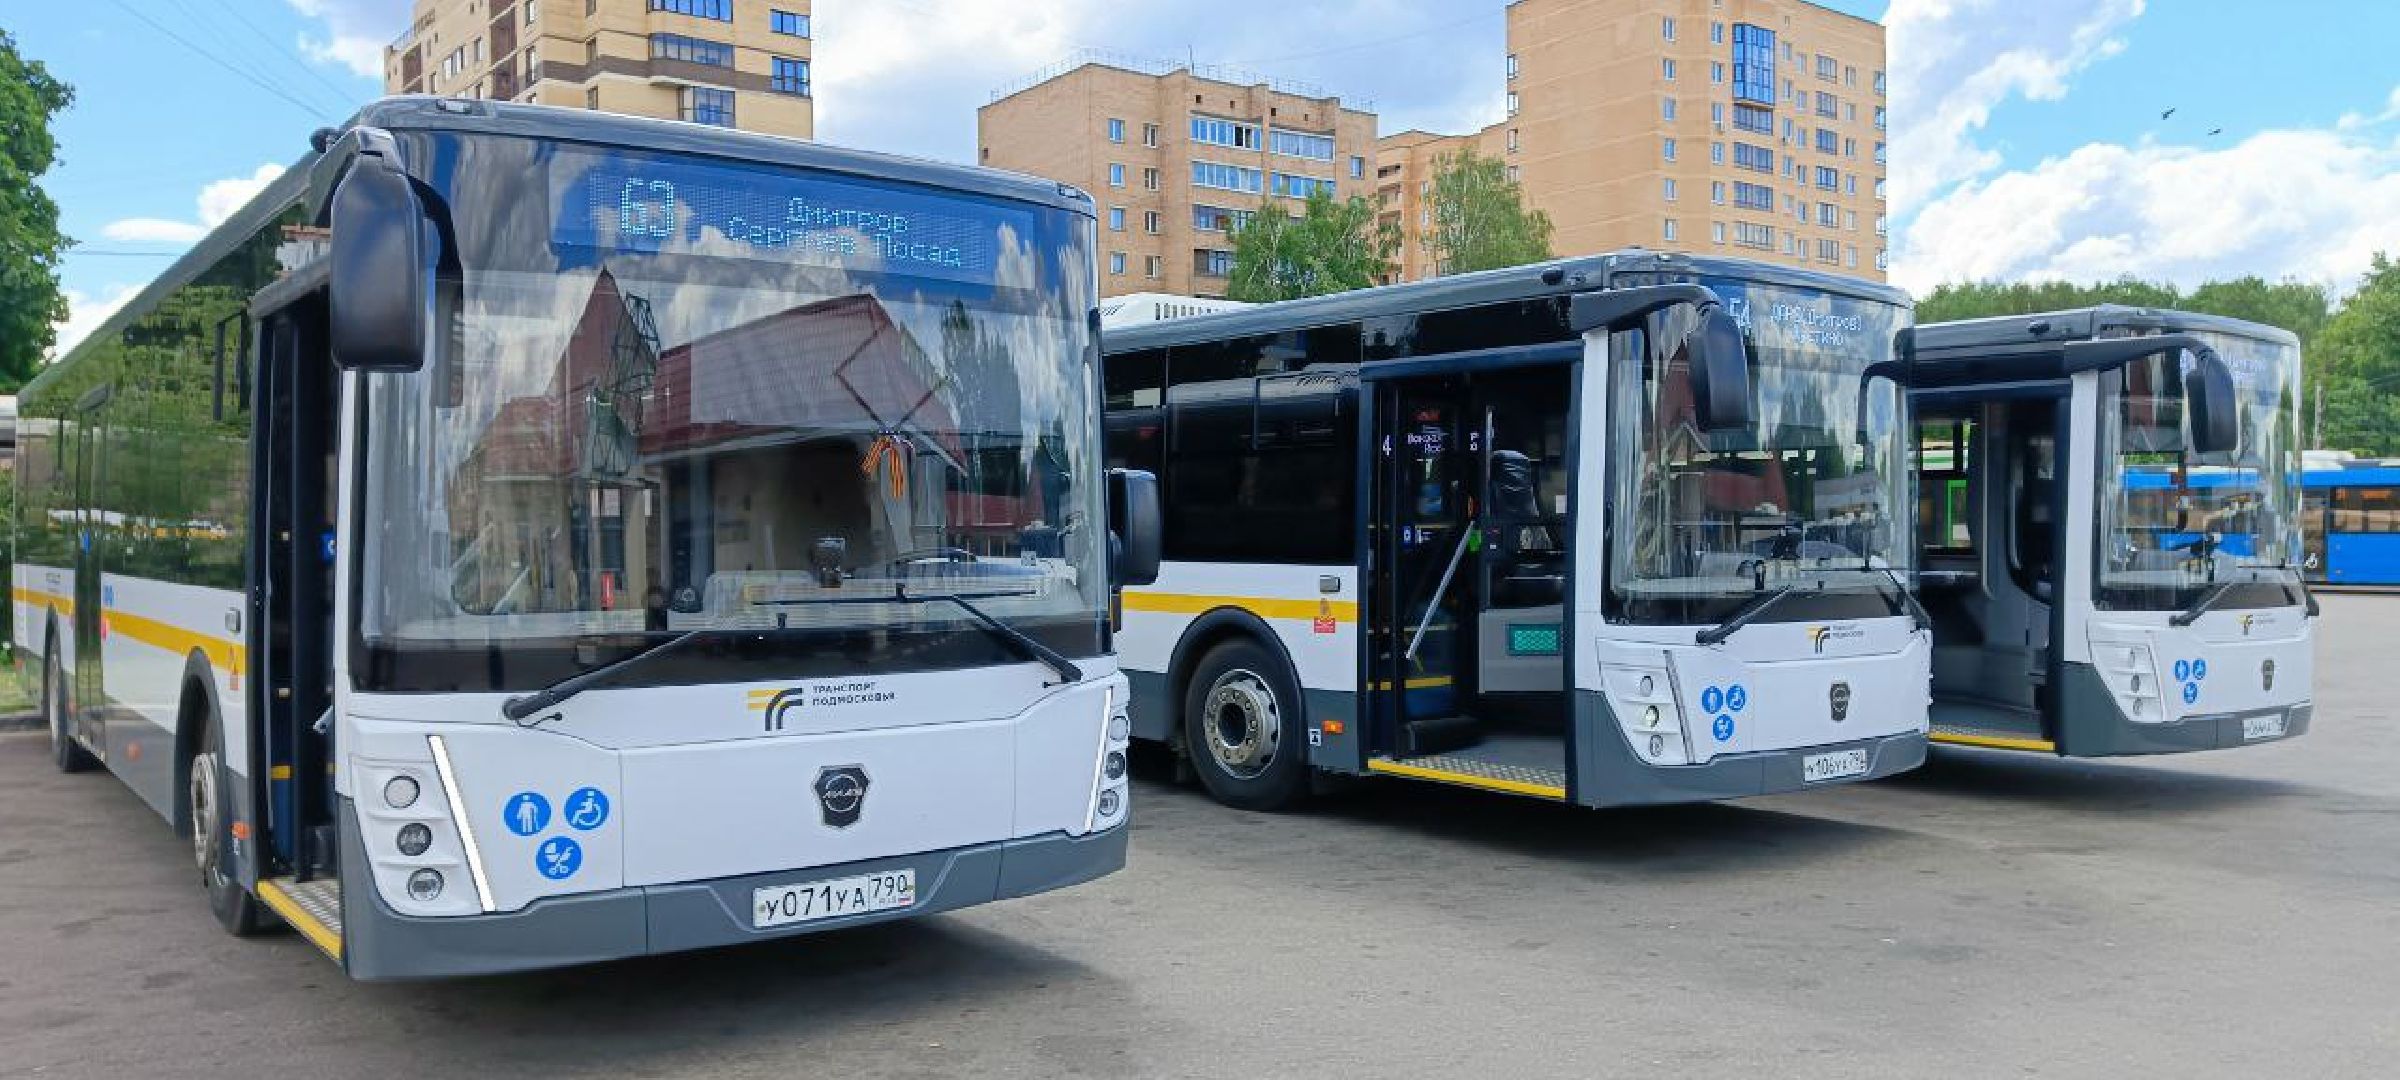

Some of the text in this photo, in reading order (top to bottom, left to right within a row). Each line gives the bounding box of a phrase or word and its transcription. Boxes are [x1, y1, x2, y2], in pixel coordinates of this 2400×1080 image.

[620, 177, 909, 238] 63 Дмитров
[873, 236, 963, 267] Посад
[812, 682, 876, 694] ТРАНСПОРТ
[812, 692, 896, 707] ПОДМОСКОВЬЯ
[765, 874, 909, 921] У071УА 790
